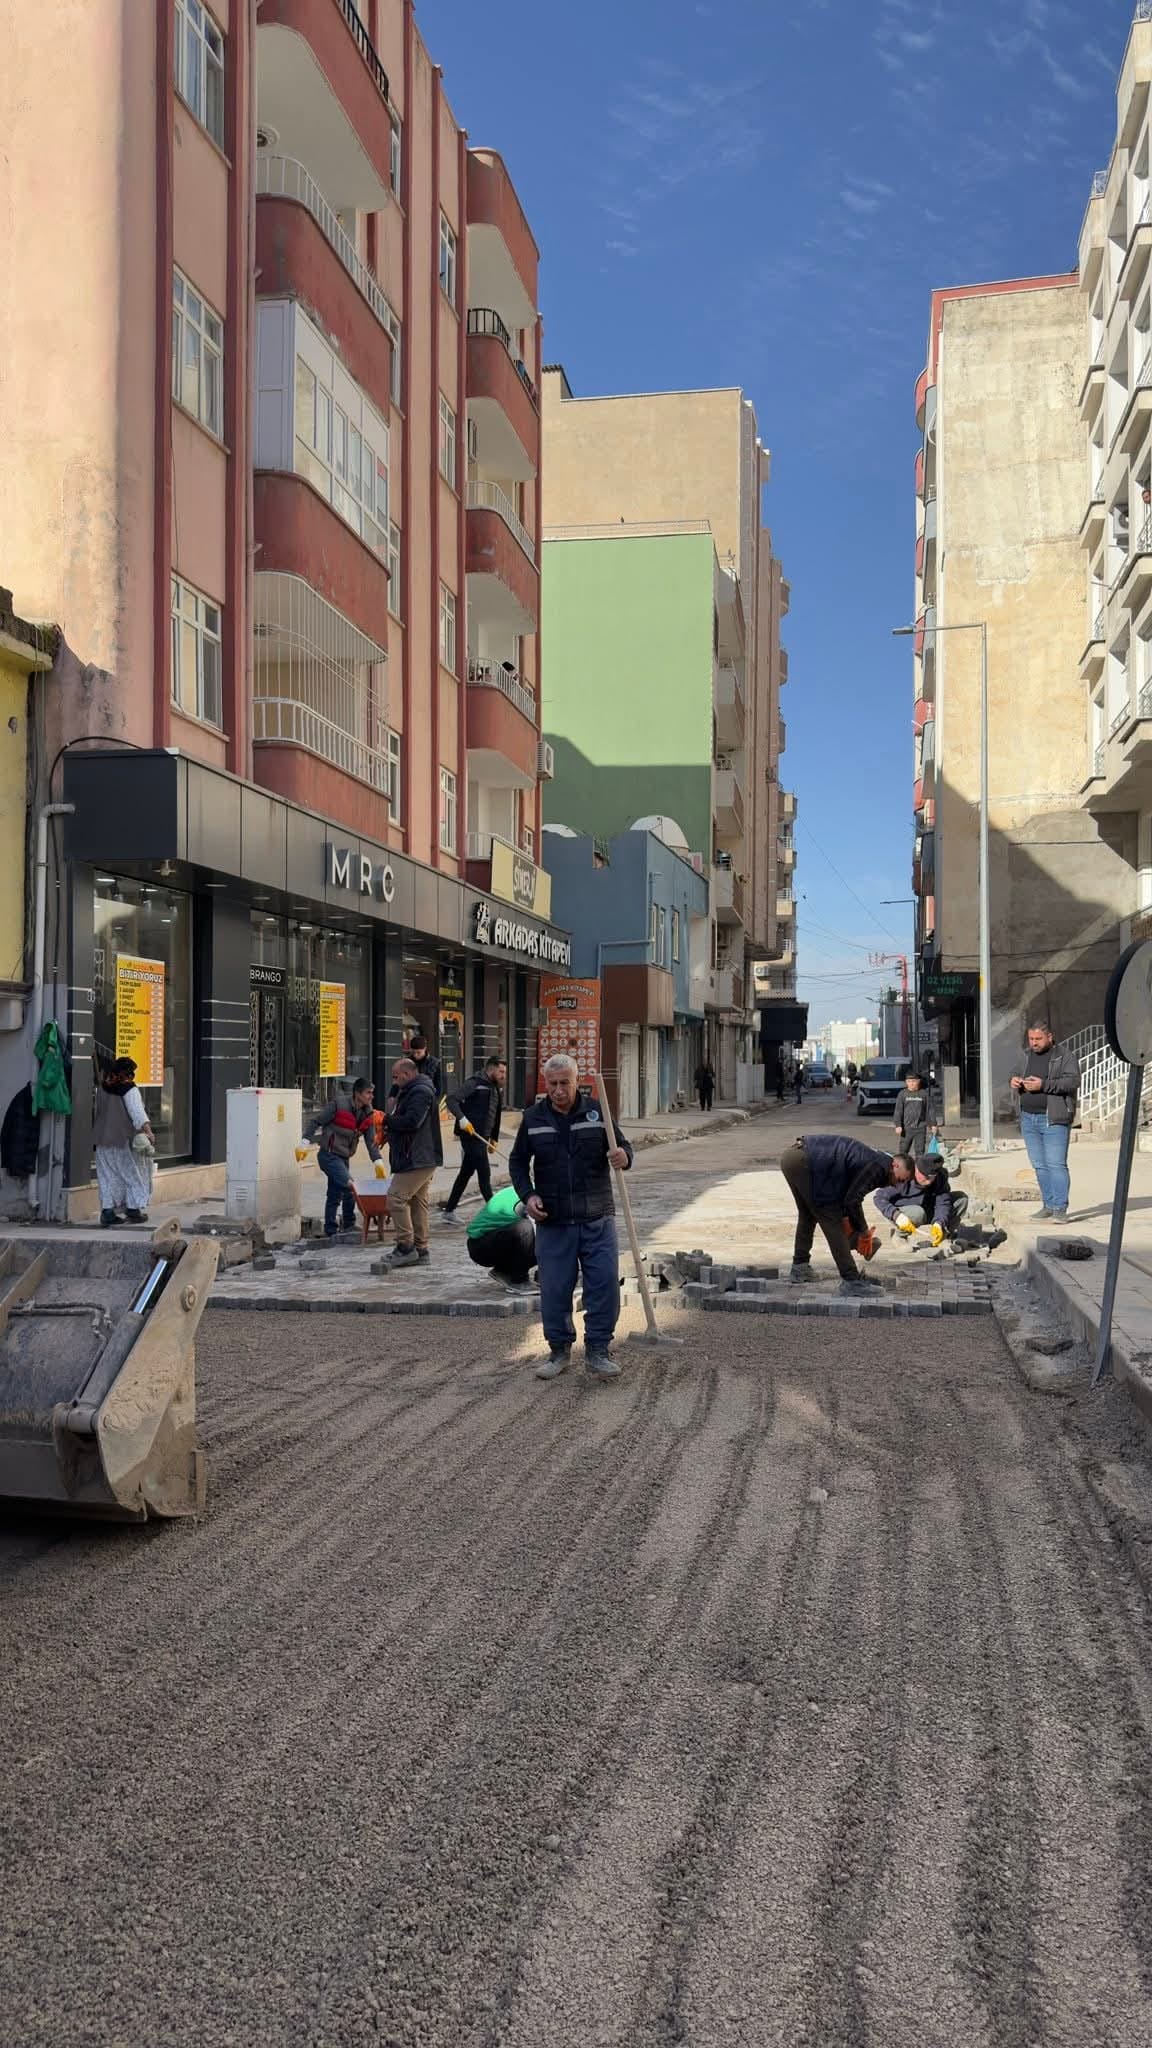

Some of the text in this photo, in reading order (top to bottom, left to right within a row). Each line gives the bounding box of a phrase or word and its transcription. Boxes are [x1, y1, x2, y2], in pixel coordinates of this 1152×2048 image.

[331, 842, 395, 903] MRC
[494, 918, 571, 966] ARKADAŞ KİTAPEVİ
[250, 969, 282, 983] BRANGO
